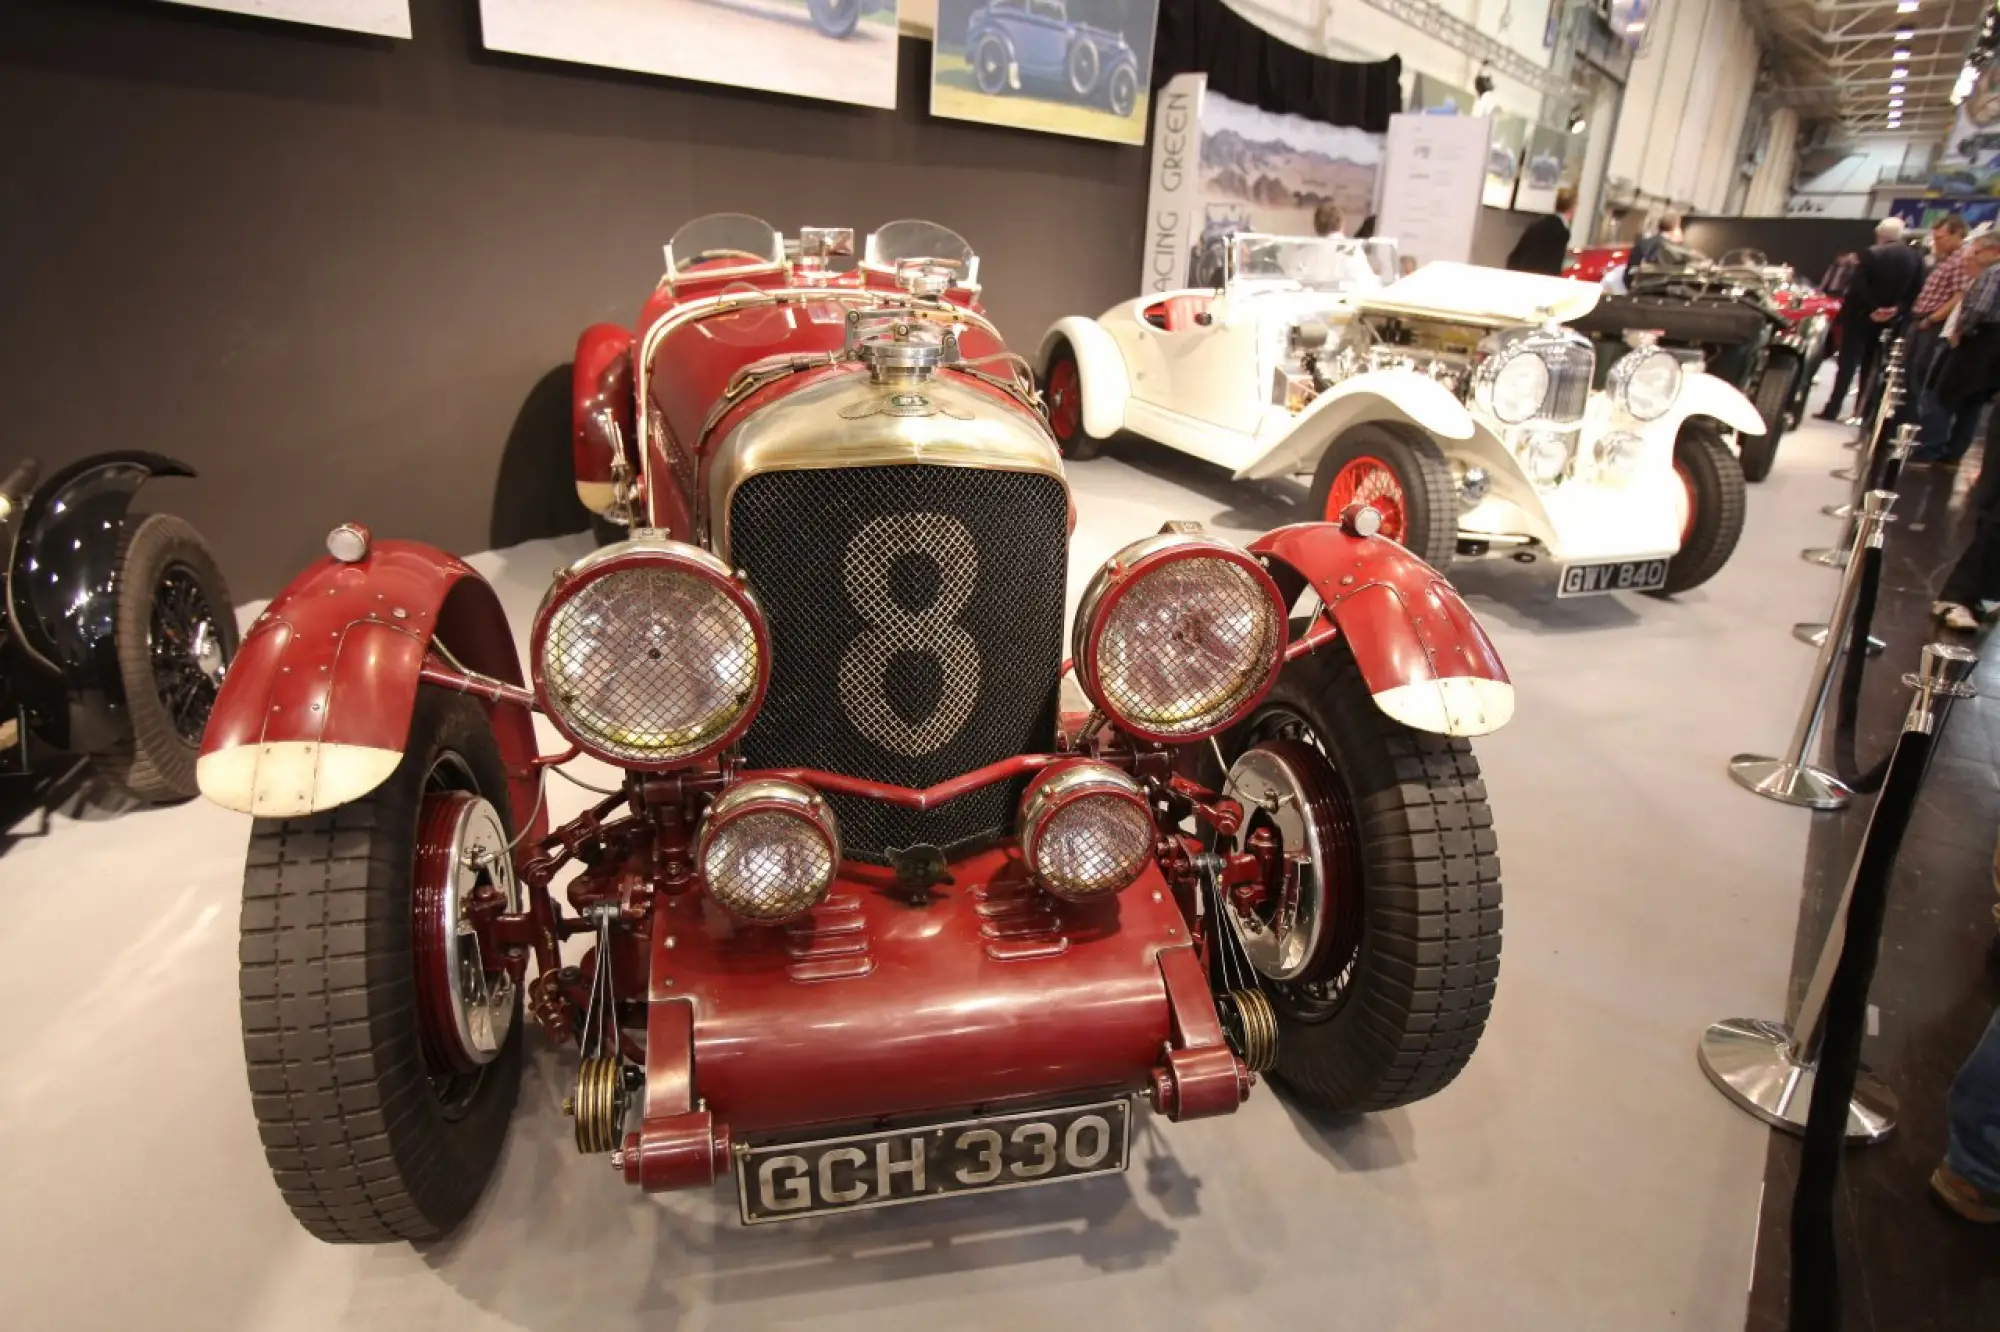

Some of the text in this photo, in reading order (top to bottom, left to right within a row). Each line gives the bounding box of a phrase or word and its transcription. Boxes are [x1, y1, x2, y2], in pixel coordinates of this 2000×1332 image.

[1151, 93, 1189, 292] ACING GREEN
[838, 511, 980, 759] 8
[1566, 560, 1663, 591] GWV 840
[758, 1114, 1111, 1211] GCH 330
